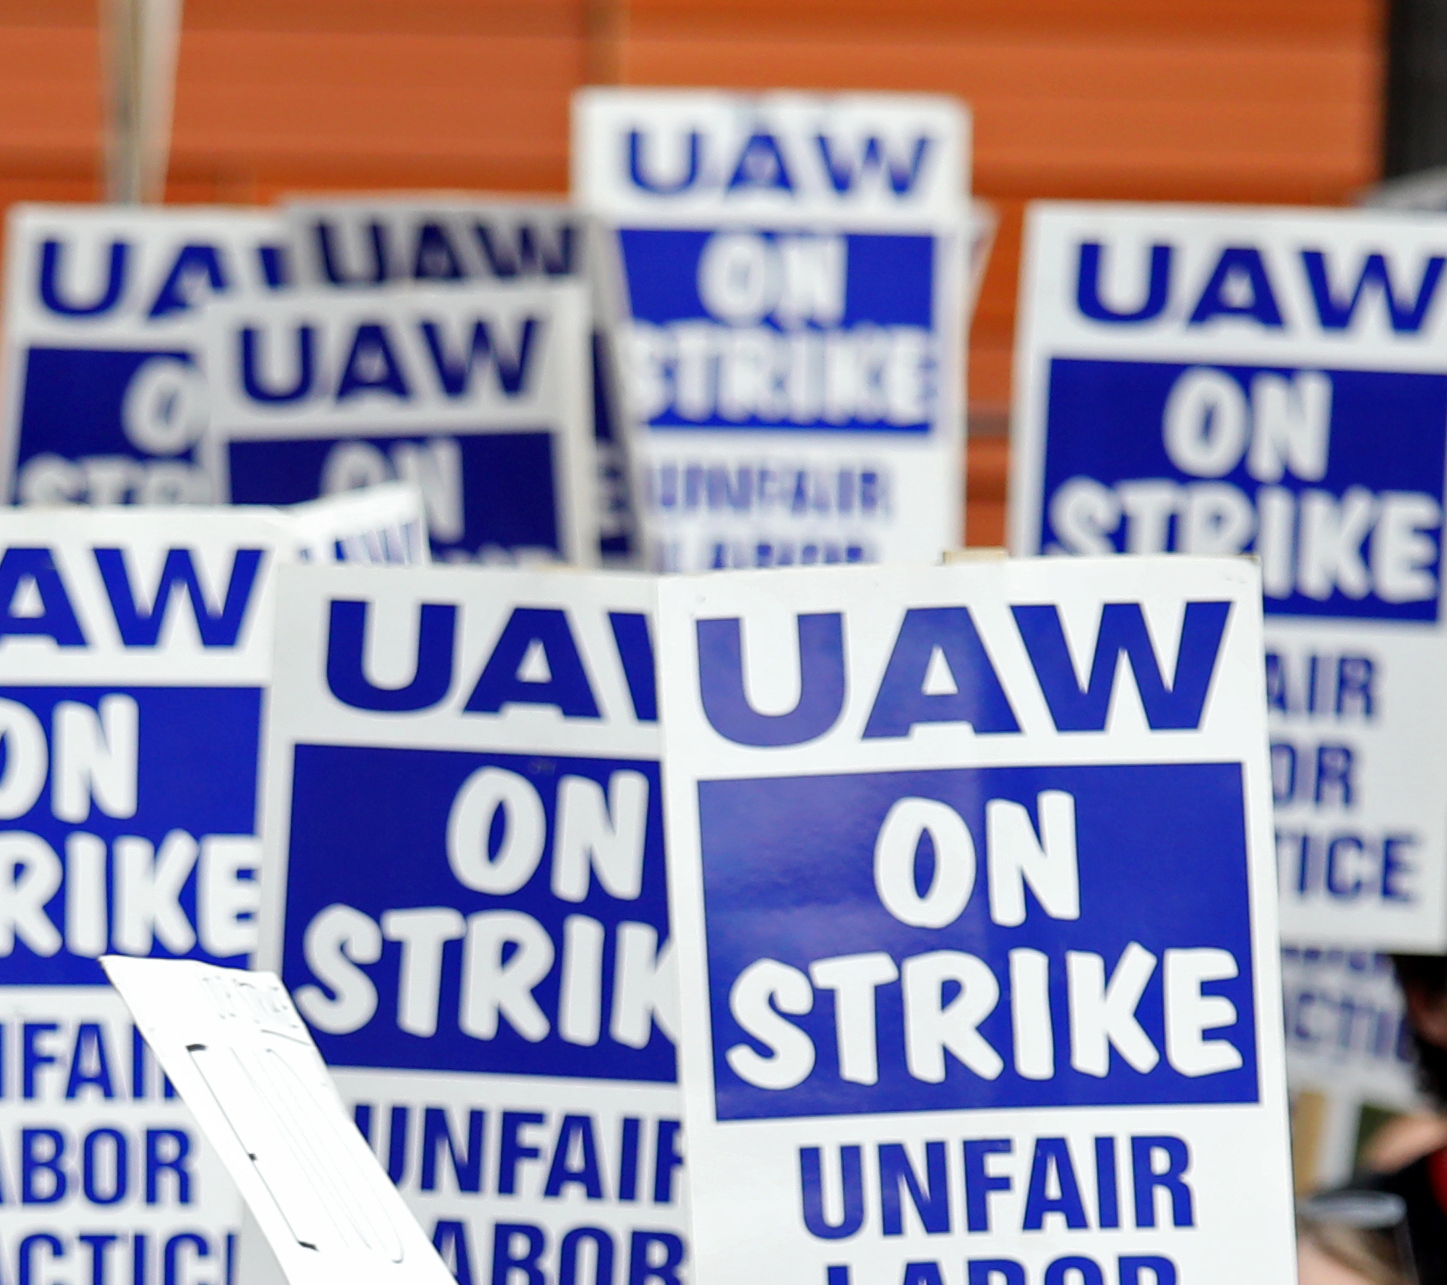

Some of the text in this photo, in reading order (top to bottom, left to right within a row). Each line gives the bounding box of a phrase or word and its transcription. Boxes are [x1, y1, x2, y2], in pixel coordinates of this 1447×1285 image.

[628, 128, 938, 198] UAW
[36, 238, 286, 322] UA
[698, 234, 852, 328] ON
[238, 320, 544, 400] UAW
[628, 320, 946, 428] STRIKE
[1161, 364, 1333, 484] ON
[318, 440, 466, 545] ON
[1048, 478, 1442, 604] STRIKE
[694, 600, 1233, 748] UAW
[1266, 652, 1386, 722] AIR
[446, 766, 650, 902] ON
[872, 789, 1082, 930] ON
[1274, 834, 1420, 906] TICE
[298, 904, 680, 1050] STRIK
[725, 940, 1244, 1092] STRIKE
[797, 1134, 1196, 1242] UNFAIR
